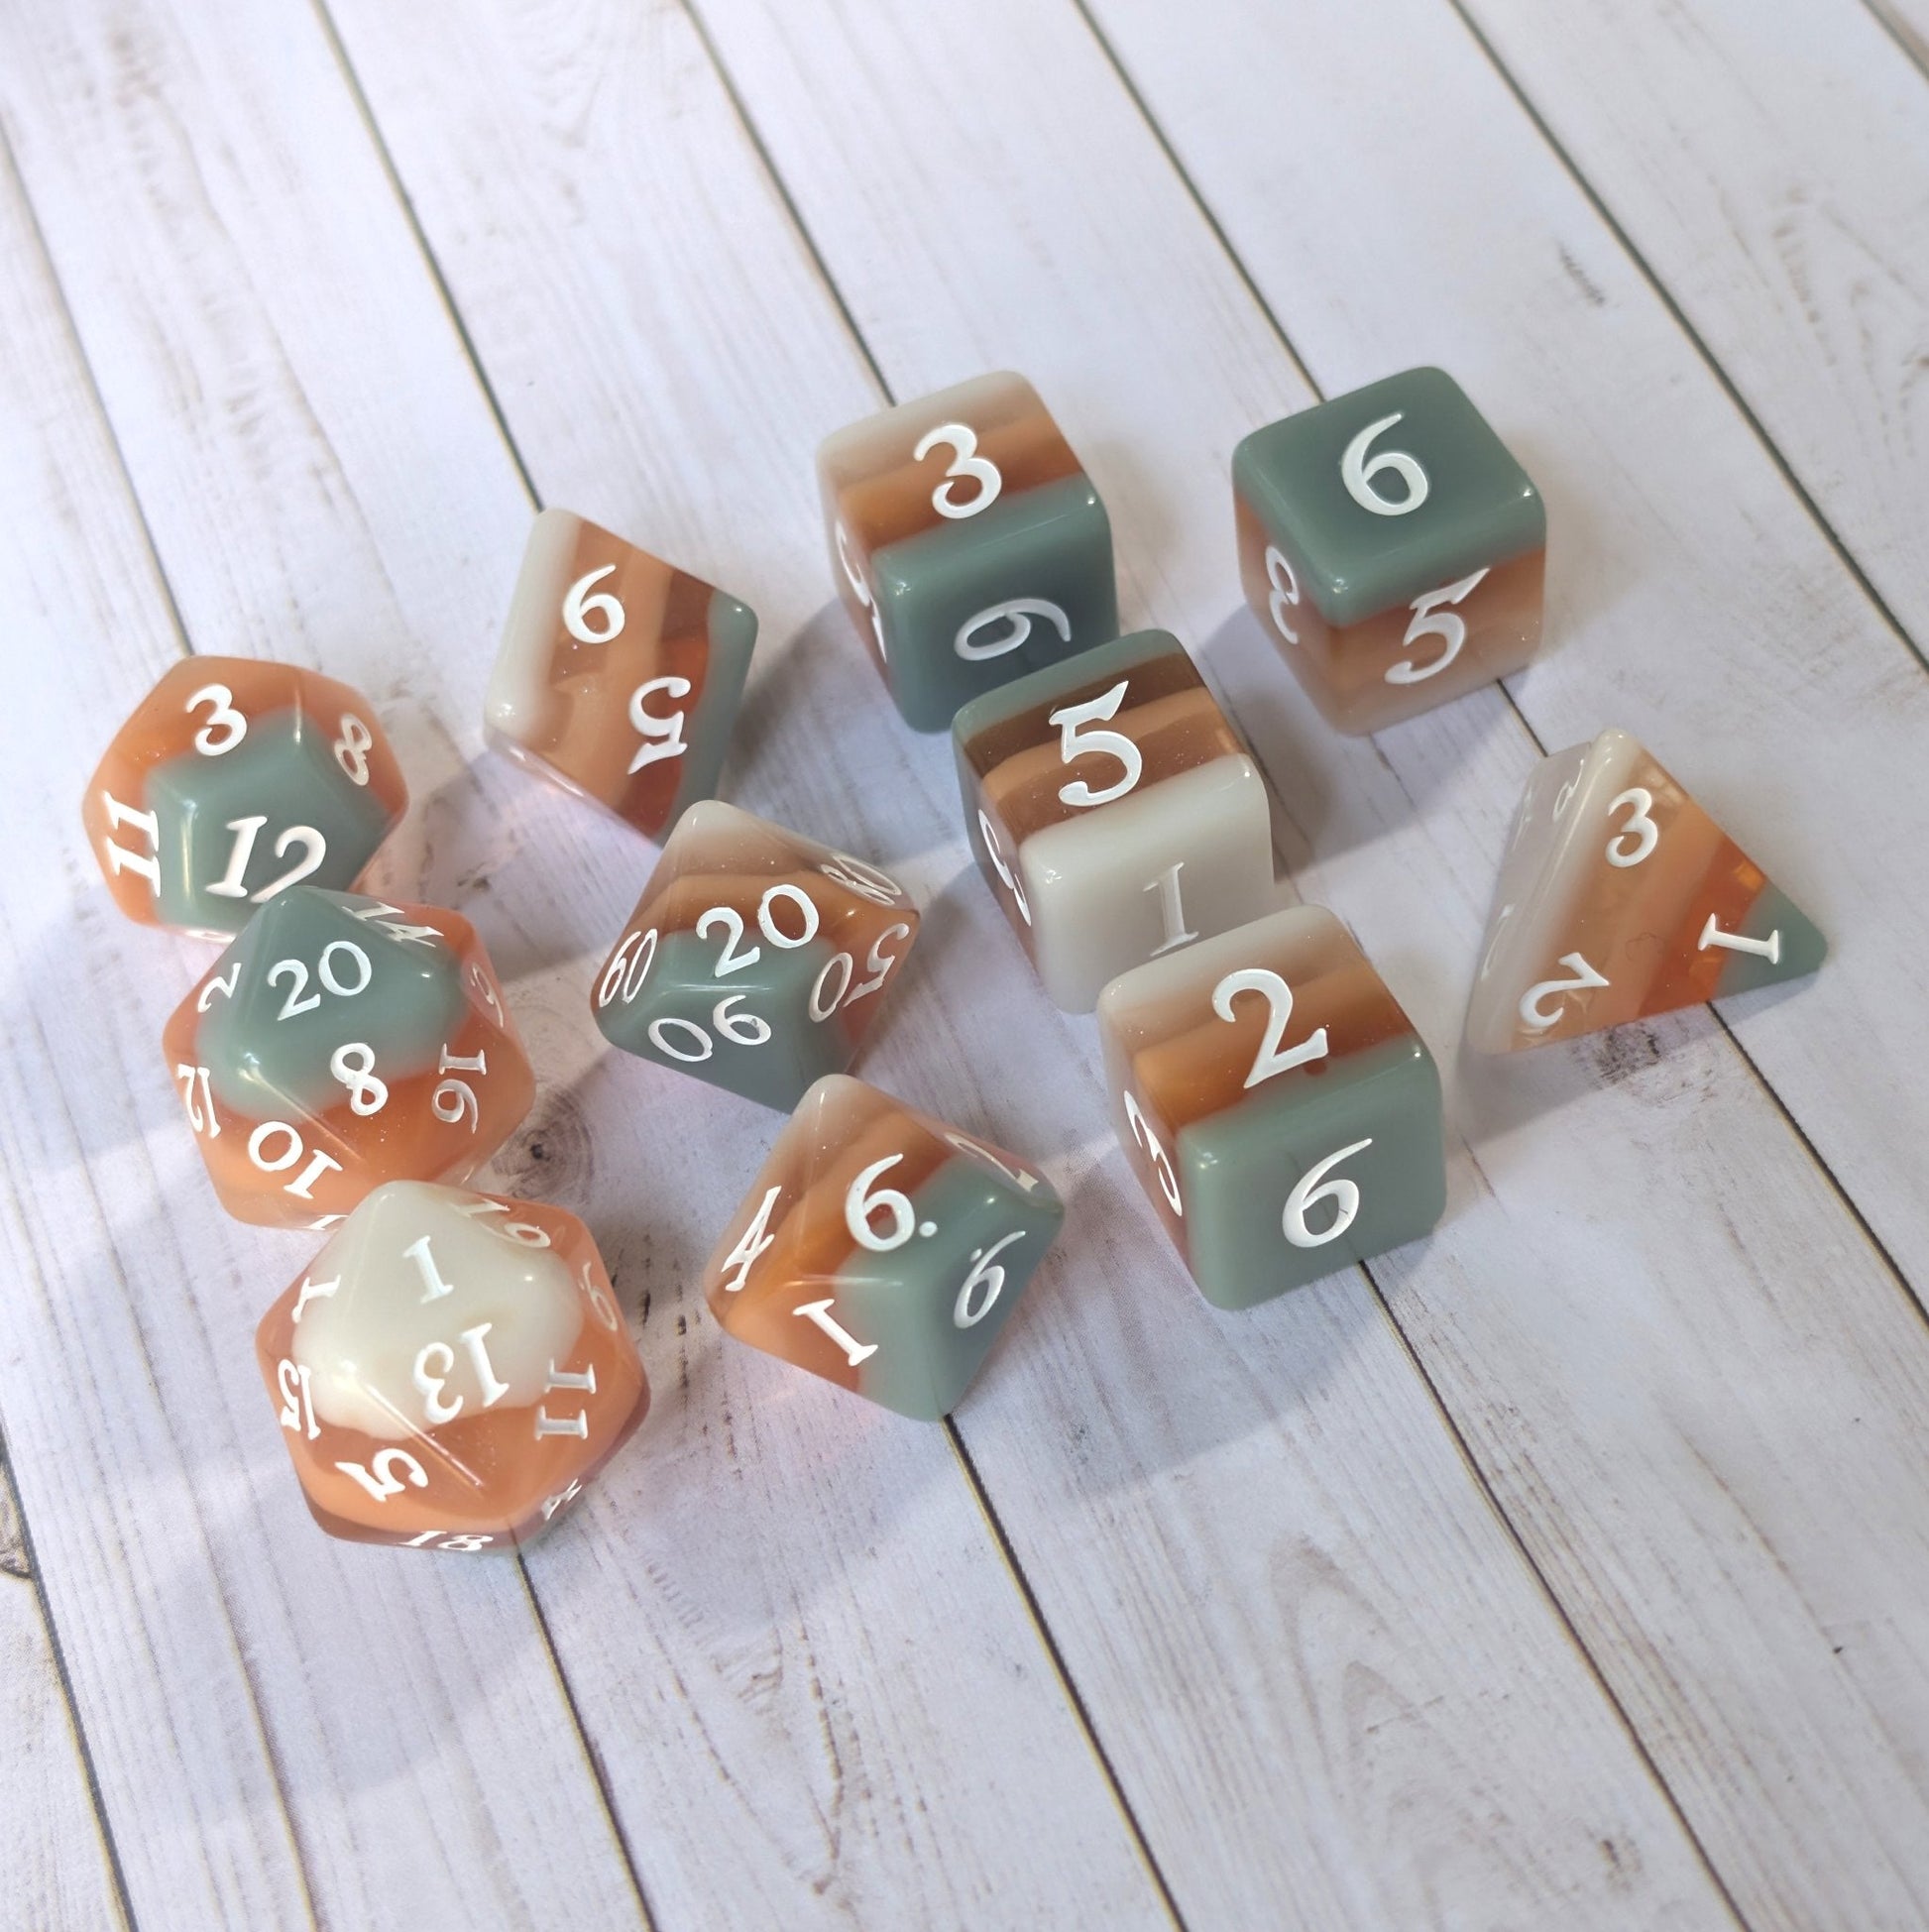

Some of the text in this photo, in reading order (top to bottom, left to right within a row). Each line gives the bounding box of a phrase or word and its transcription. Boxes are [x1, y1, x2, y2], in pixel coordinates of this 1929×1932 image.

[913, 423, 1002, 519] 3
[1340, 412, 1428, 516] 6
[562, 563, 625, 644] 6
[1265, 545, 1300, 645] 3
[1385, 567, 1491, 685] 5
[185, 683, 248, 756] 3
[334, 713, 372, 786] 8
[627, 676, 692, 775] 5
[1048, 680, 1143, 808] 5
[102, 790, 162, 898] 11
[204, 816, 326, 903] 12
[1605, 787, 1658, 868] 3
[696, 884, 820, 978] 20
[1143, 861, 1198, 958] 1
[1697, 912, 1779, 966] 1
[197, 963, 241, 1013] 2
[267, 941, 372, 1021] 20
[599, 928, 658, 1008] 60
[808, 923, 910, 1023] 50
[1520, 952, 1610, 1029] 2
[1211, 967, 1329, 1090] 2
[176, 1064, 221, 1139] 12
[330, 1042, 389, 1116] 8
[431, 1043, 487, 1134] 16
[248, 1120, 343, 1199] 10
[1124, 1089, 1183, 1217] 3
[1282, 1138, 1373, 1248] 6
[402, 1235, 454, 1305] 1
[721, 1186, 782, 1292] 4
[412, 1322, 510, 1424] 13
[792, 1299, 878, 1367] 1
[278, 1359, 321, 1440] 15
[534, 1358, 597, 1441] 11
[334, 1447, 428, 1503] 5
[397, 1531, 494, 1551] 18
